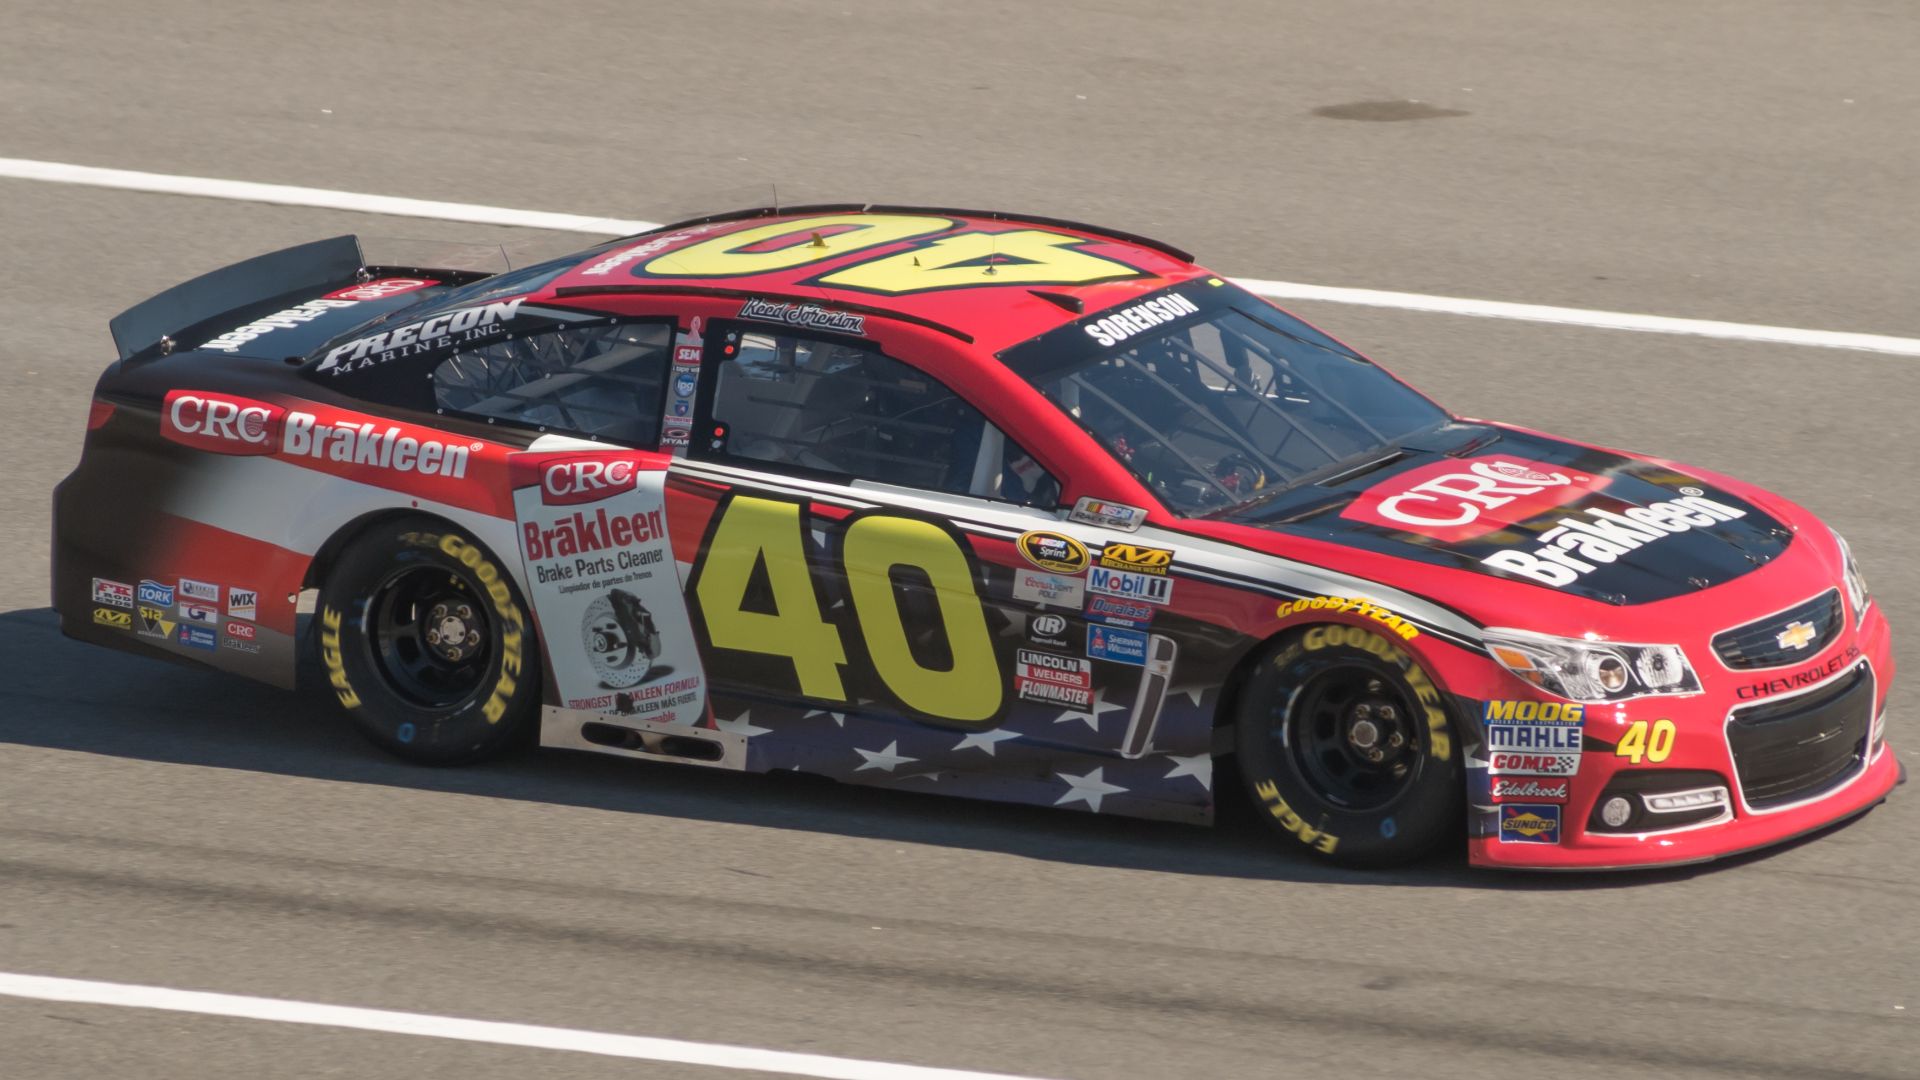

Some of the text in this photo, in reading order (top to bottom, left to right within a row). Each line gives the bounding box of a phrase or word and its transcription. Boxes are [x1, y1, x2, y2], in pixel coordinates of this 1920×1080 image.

[740, 298, 864, 334] Reed Sorenson
[1084, 293, 1199, 347] SORENSON
[316, 297, 528, 371] PRECON
[465, 322, 506, 342] INC.
[678, 348, 700, 360] SEM
[170, 395, 271, 443] CRC
[545, 460, 635, 496] CRC
[1377, 461, 1571, 526] CRC
[1075, 512, 1132, 530] RACE CAR
[1039, 545, 1067, 560] Sprint
[536, 548, 664, 584] Brake Parts Cleaner
[1143, 565, 1168, 577] WEAR
[1091, 568, 1163, 598] Mobil 1
[140, 587, 172, 604] TORK
[230, 592, 256, 607] WIX
[696, 495, 1004, 721] 40
[1093, 598, 1151, 620] Duralast
[1277, 596, 1420, 641] GOODYEAR
[227, 623, 254, 638] CRC
[1038, 616, 1063, 634] IR
[1109, 634, 1144, 648] SHERWIN
[1020, 652, 1078, 673] LINCOLN
[1033, 667, 1083, 686] WELDERS
[1736, 653, 1845, 701] CHEVROLET
[1019, 679, 1089, 706] FLOWMASTER
[1486, 700, 1584, 722] MOOG
[1491, 726, 1580, 748] MAHLE
[1615, 719, 1676, 764] 40
[1493, 754, 1557, 770] COMP
[1492, 779, 1567, 798] Edelbrock
[1255, 779, 1340, 854] EAGLE
[1503, 818, 1555, 830] SUNOCO
